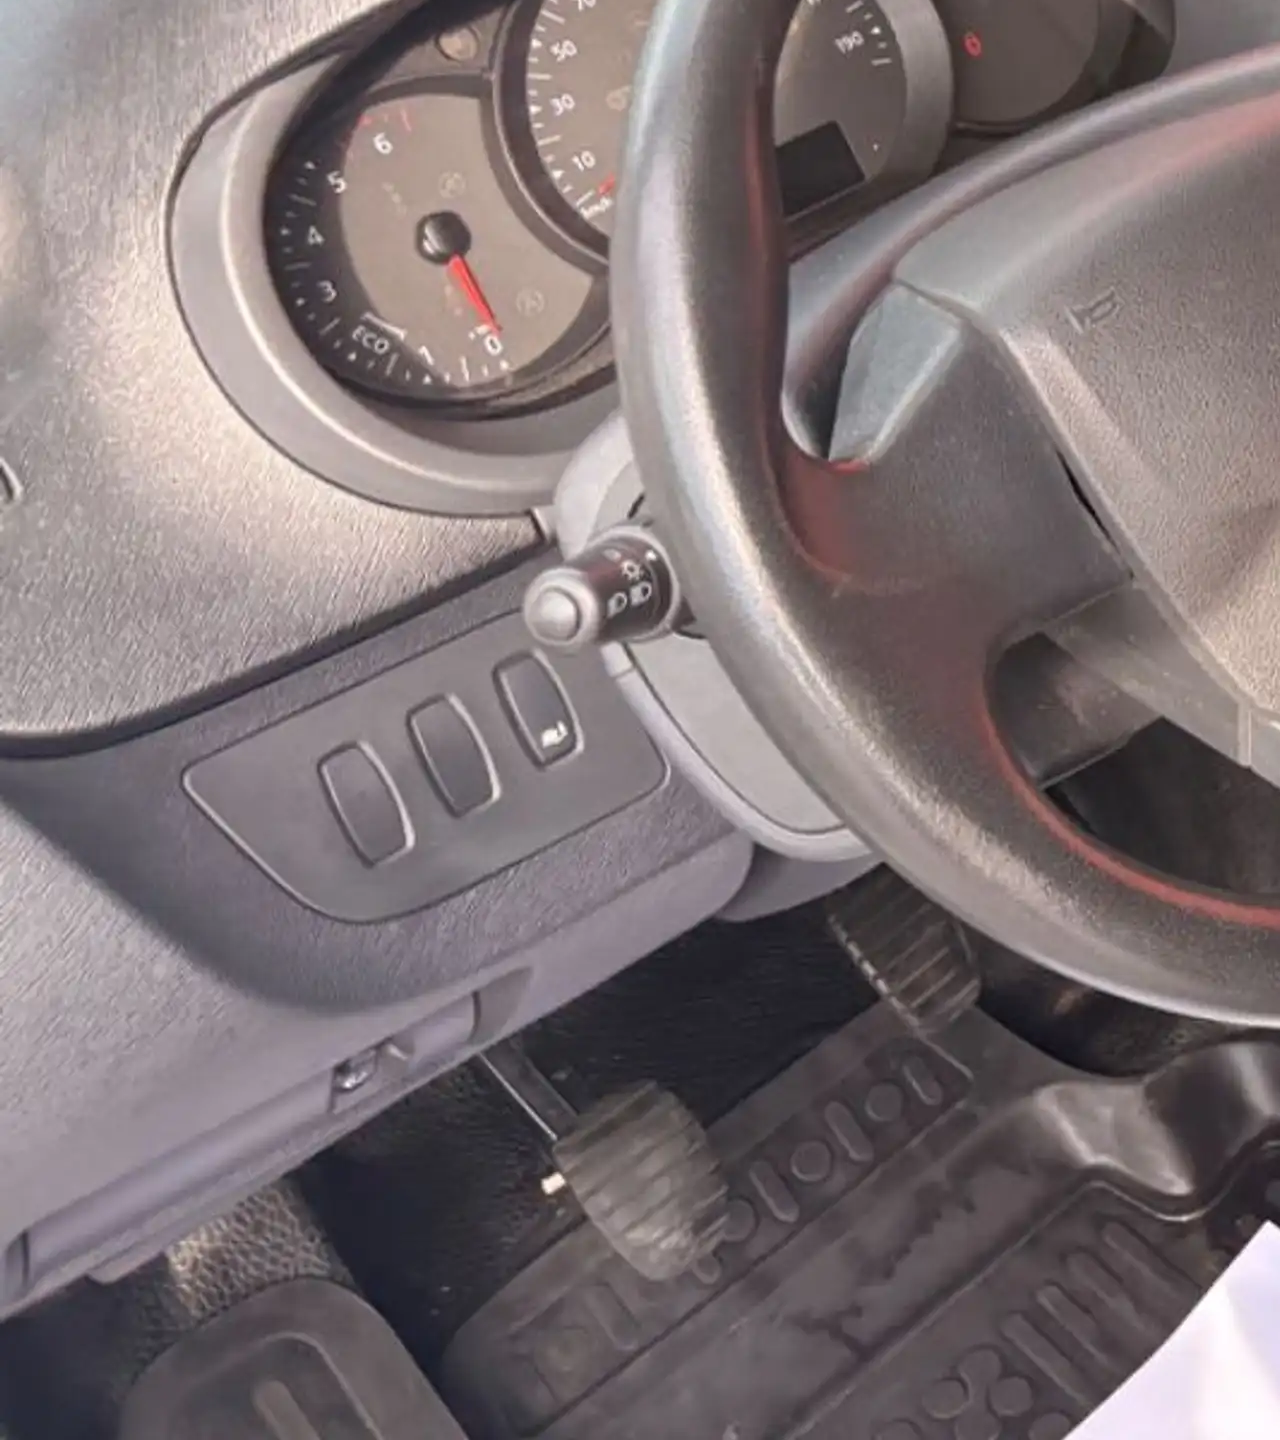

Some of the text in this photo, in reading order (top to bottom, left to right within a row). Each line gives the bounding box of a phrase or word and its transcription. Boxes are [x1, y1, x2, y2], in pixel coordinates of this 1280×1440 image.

[551, 39, 577, 63] 50
[551, 93, 575, 116] 30
[373, 133, 393, 155] 6
[572, 150, 596, 172] 10
[327, 171, 347, 194] 5
[307, 225, 325, 246] 4
[317, 280, 337, 302] 3
[352, 324, 389, 355] ECO
[485, 334, 502, 356] 0
